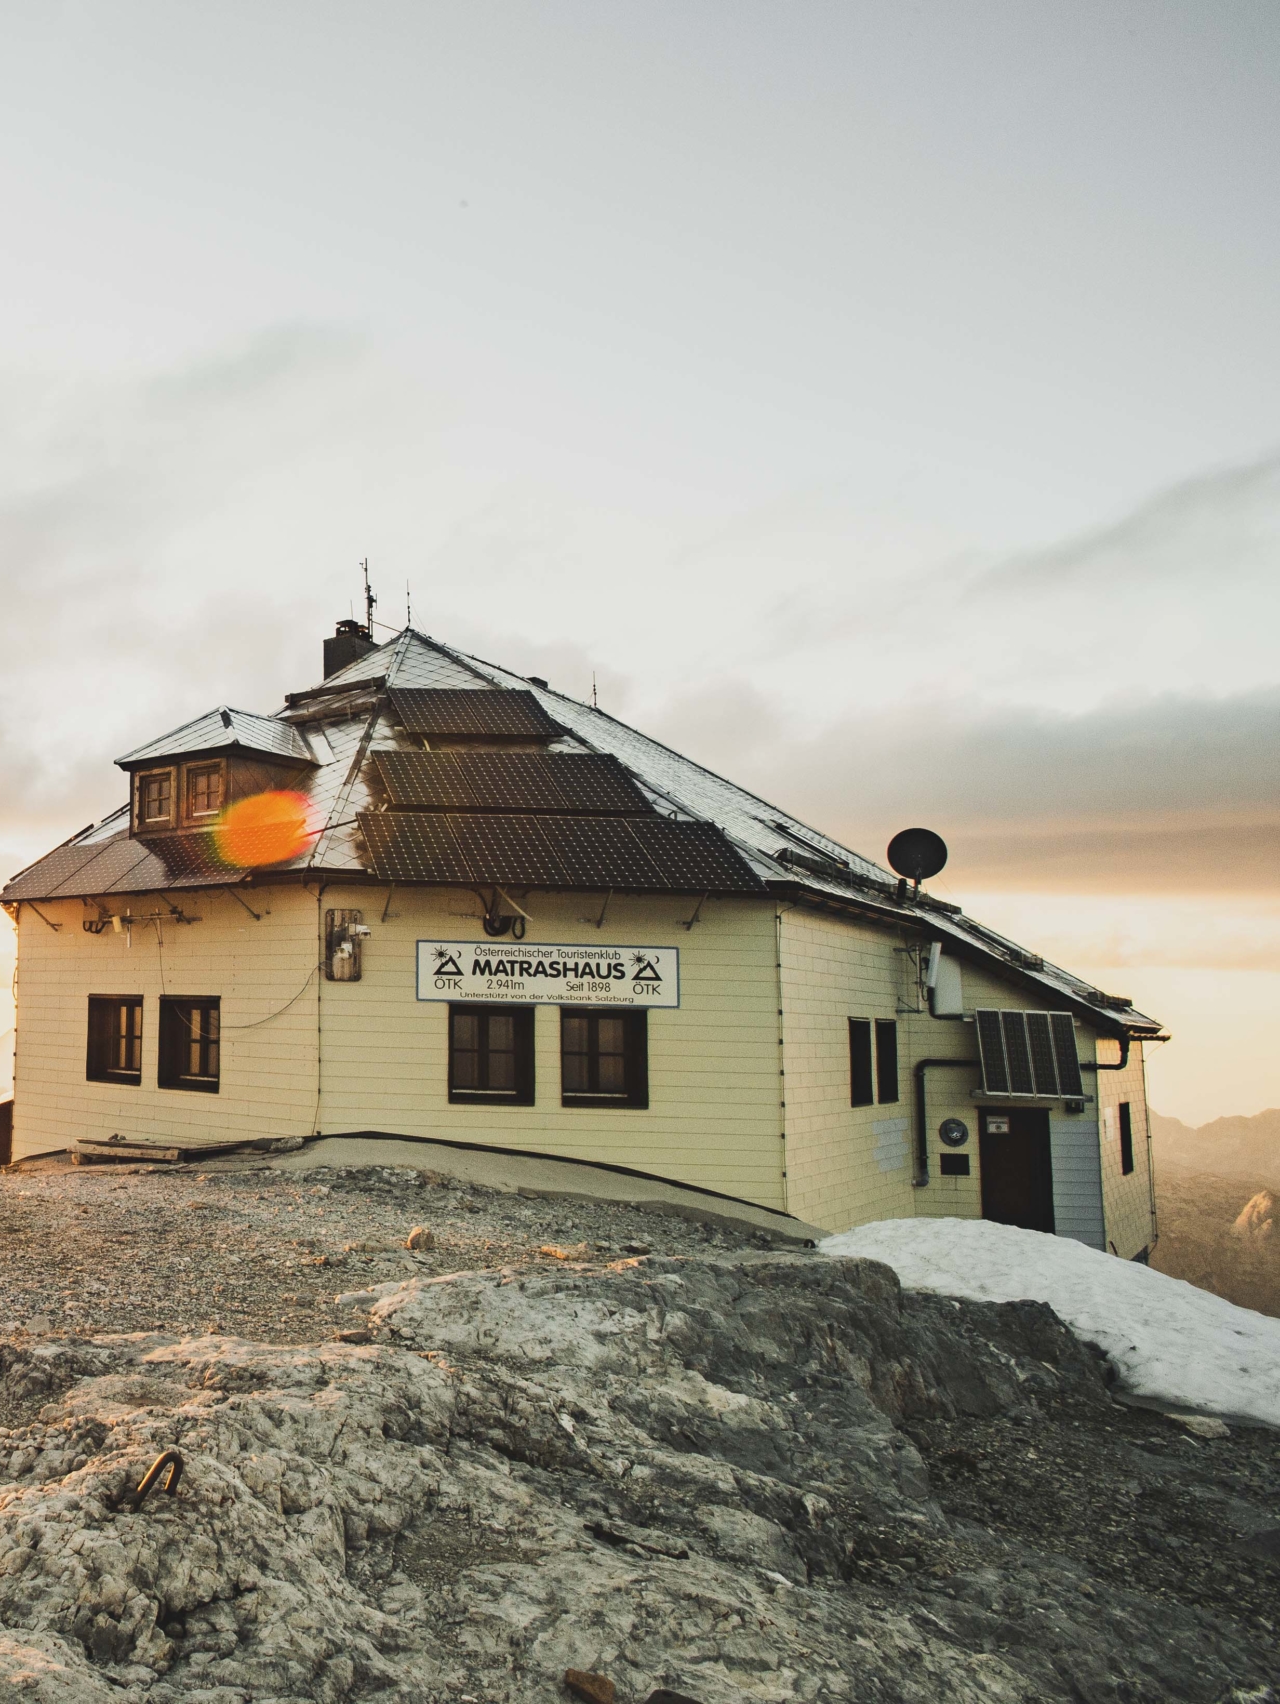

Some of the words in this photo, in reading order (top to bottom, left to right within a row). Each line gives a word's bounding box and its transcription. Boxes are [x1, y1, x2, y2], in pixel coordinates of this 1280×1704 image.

[474, 945, 553, 959] Österreichischer
[556, 948, 621, 960] Touristenklub
[471, 958, 626, 980] MATRASHAUS
[434, 976, 463, 990] ÖTK
[486, 978, 525, 990] 2.941m
[566, 981, 584, 992] Seit
[587, 981, 611, 993] 1898
[632, 981, 661, 996] ÖTK
[546, 994, 593, 1002] Volksbank
[595, 995, 634, 1004] Salzburg
